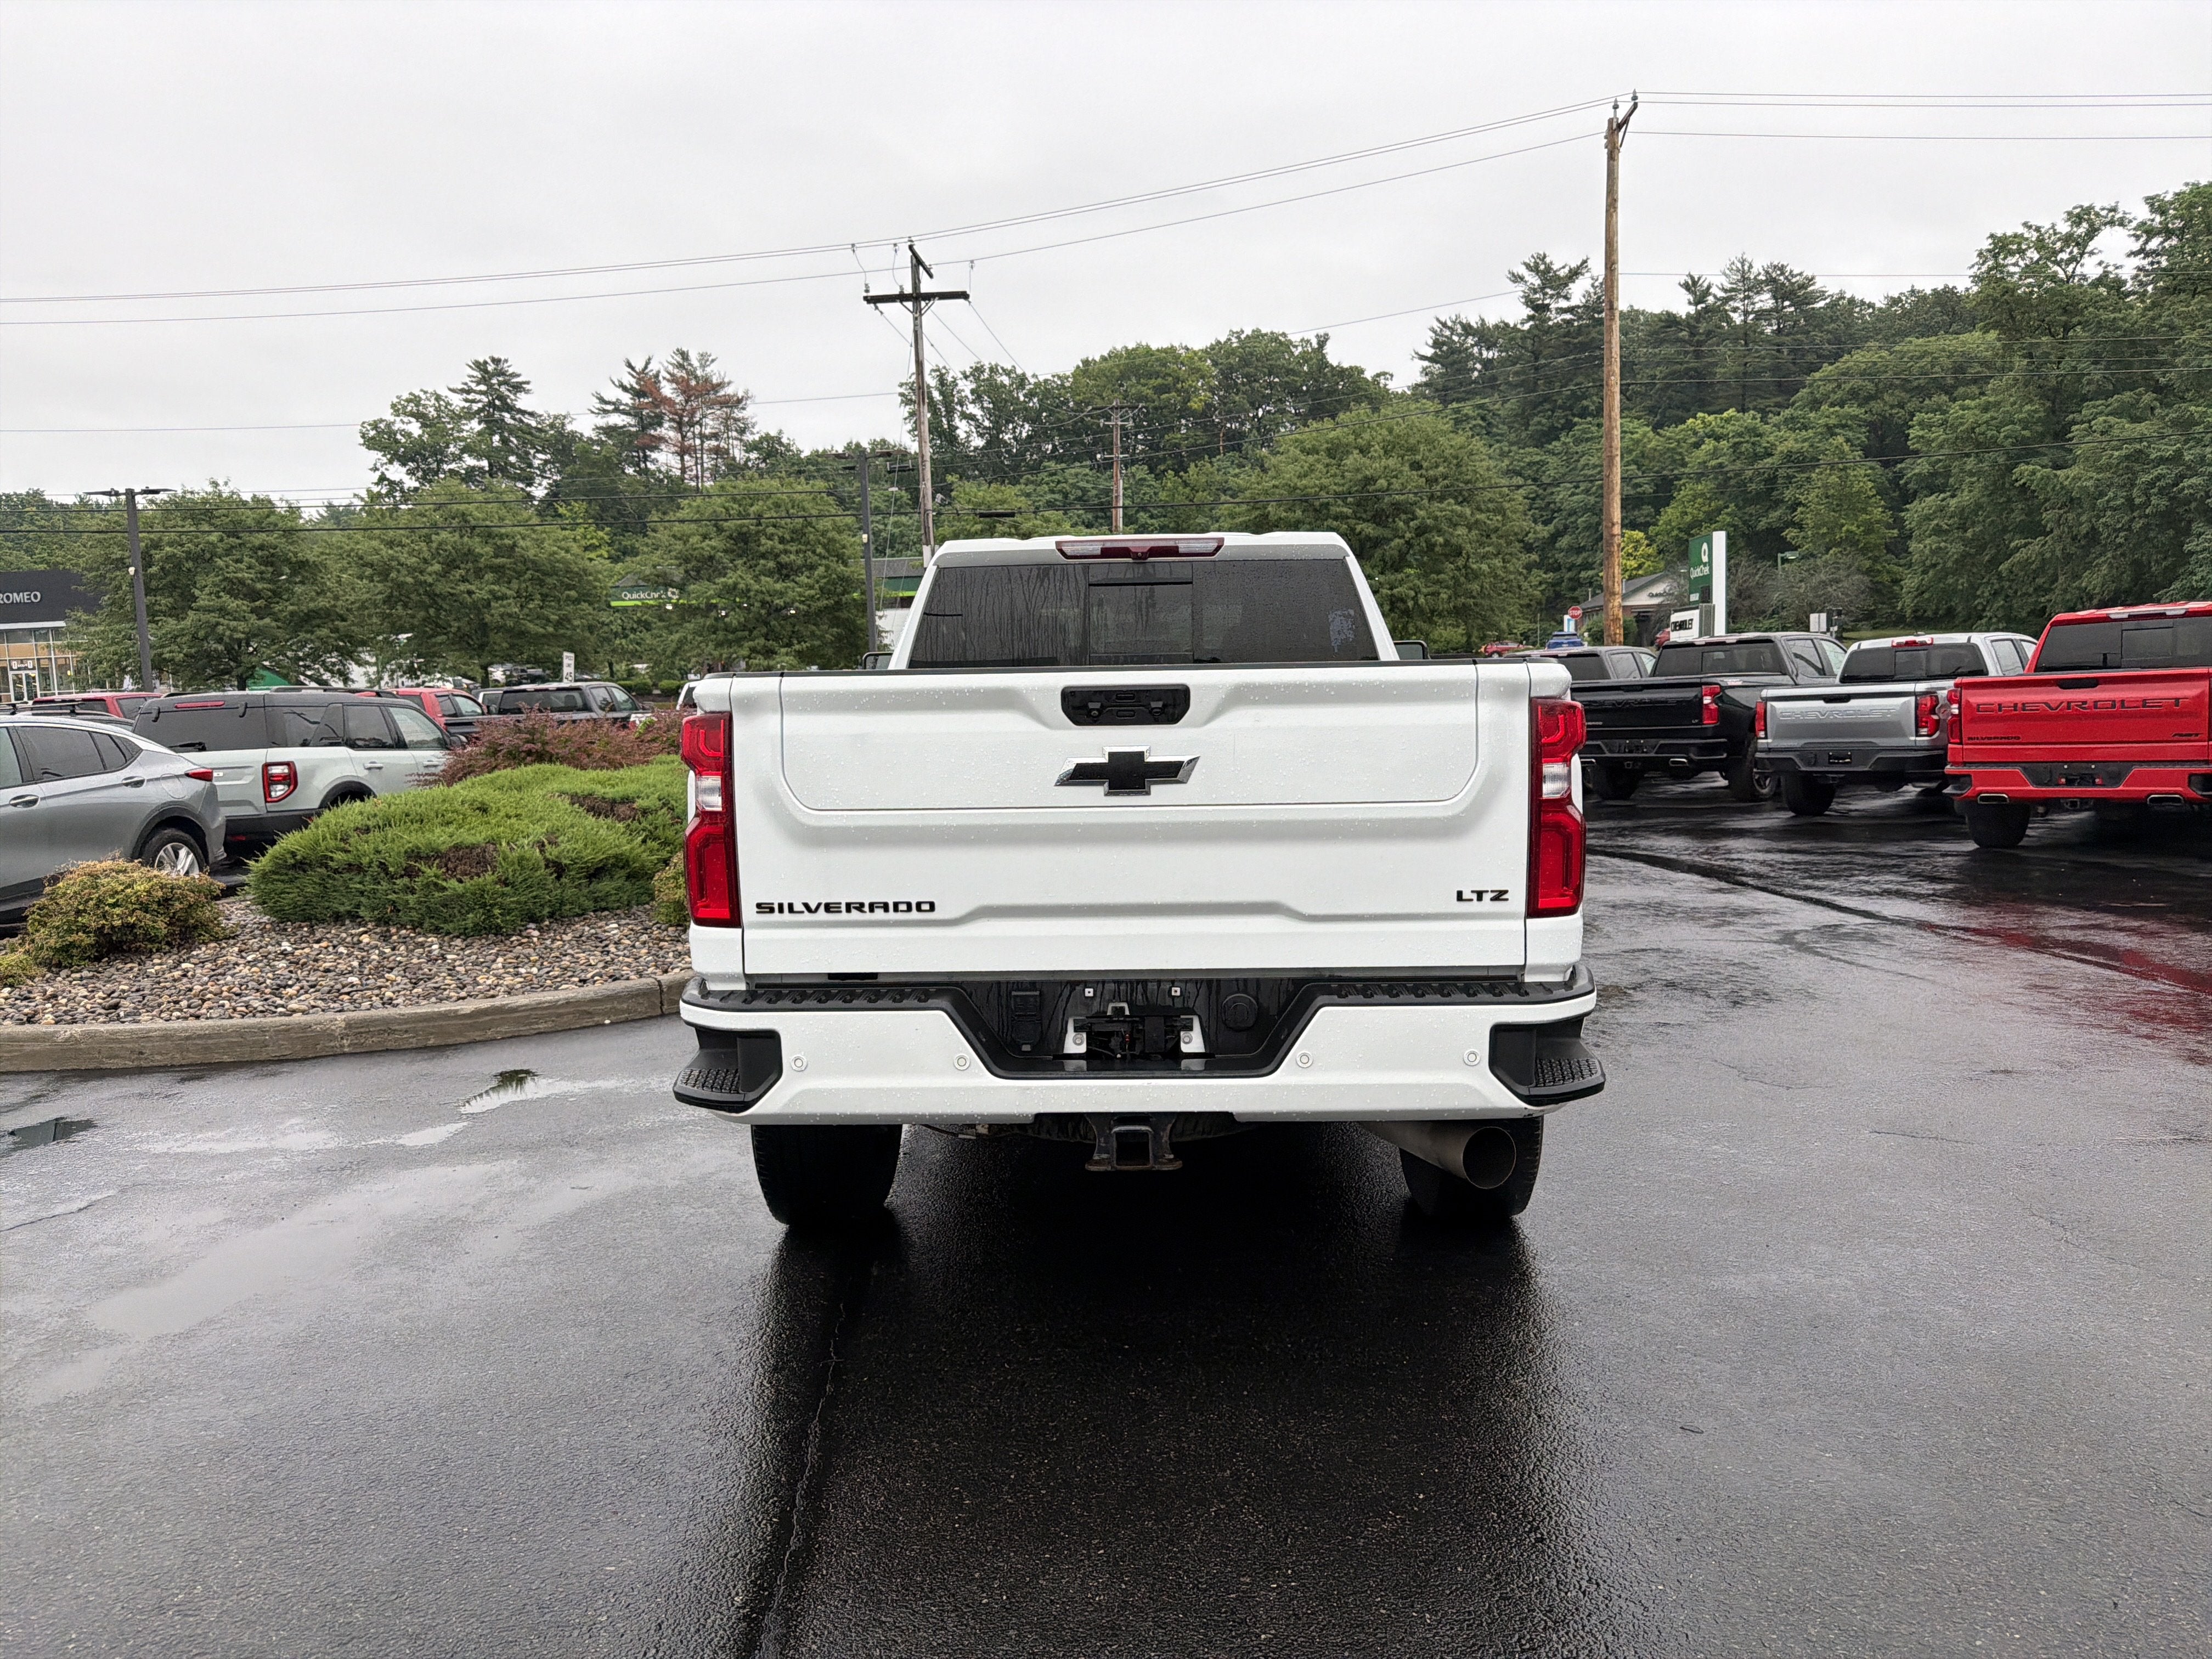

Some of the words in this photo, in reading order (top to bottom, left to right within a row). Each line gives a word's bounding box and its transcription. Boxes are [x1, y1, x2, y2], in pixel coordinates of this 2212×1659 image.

[565, 672, 573, 682] 45
[1976, 698, 2190, 713] CHEVROLET
[1779, 708, 1897, 720] CHEVROLET
[1456, 889, 1509, 902] LTZ
[755, 901, 936, 914] SILVERADO
